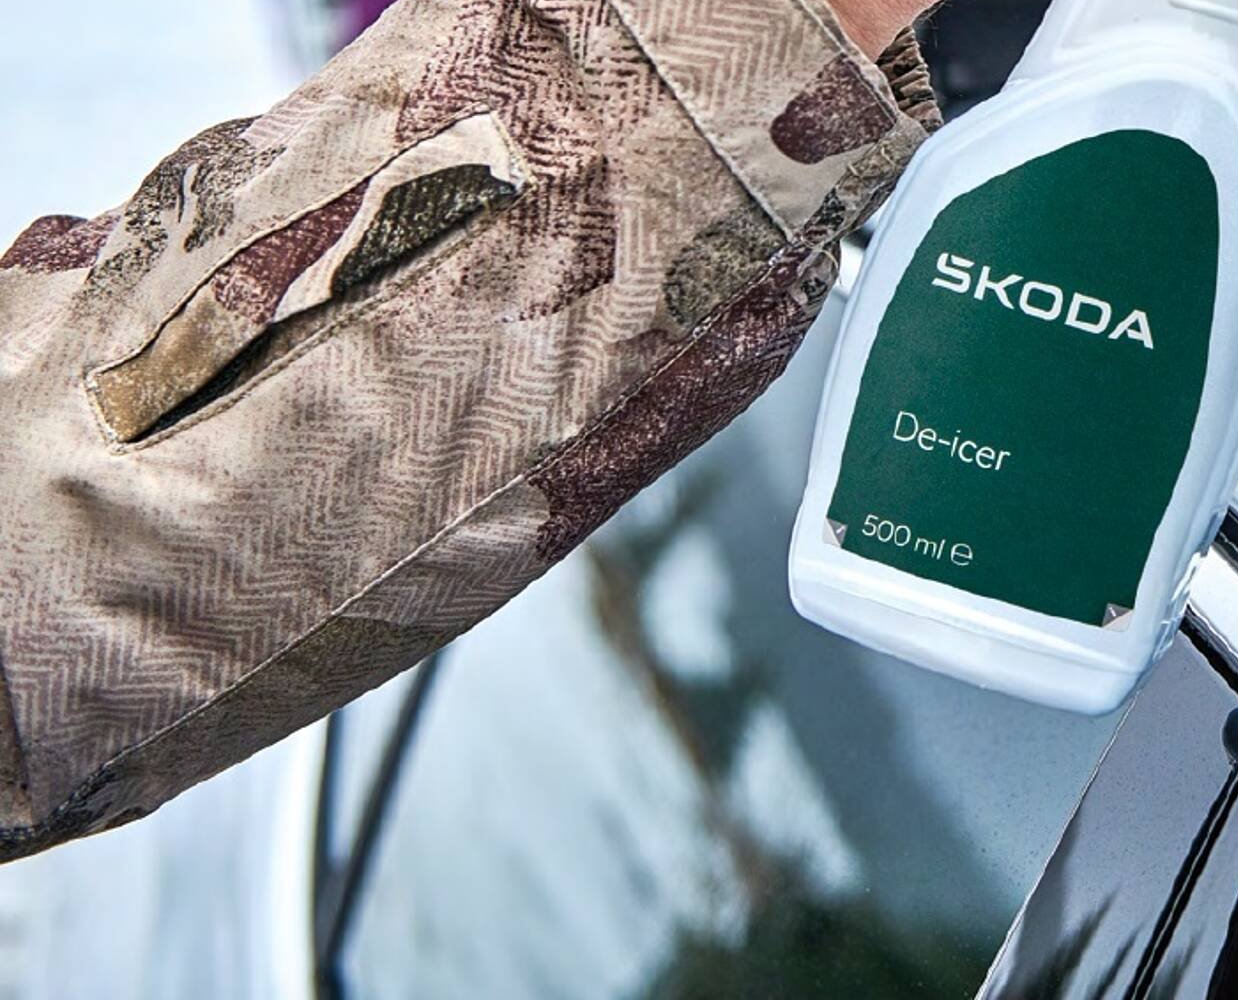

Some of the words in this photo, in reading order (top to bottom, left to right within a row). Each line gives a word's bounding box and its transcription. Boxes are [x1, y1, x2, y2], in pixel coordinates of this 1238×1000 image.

[892, 410, 1011, 471] De-icer
[861, 514, 911, 547] 500
[914, 537, 946, 560] ml
